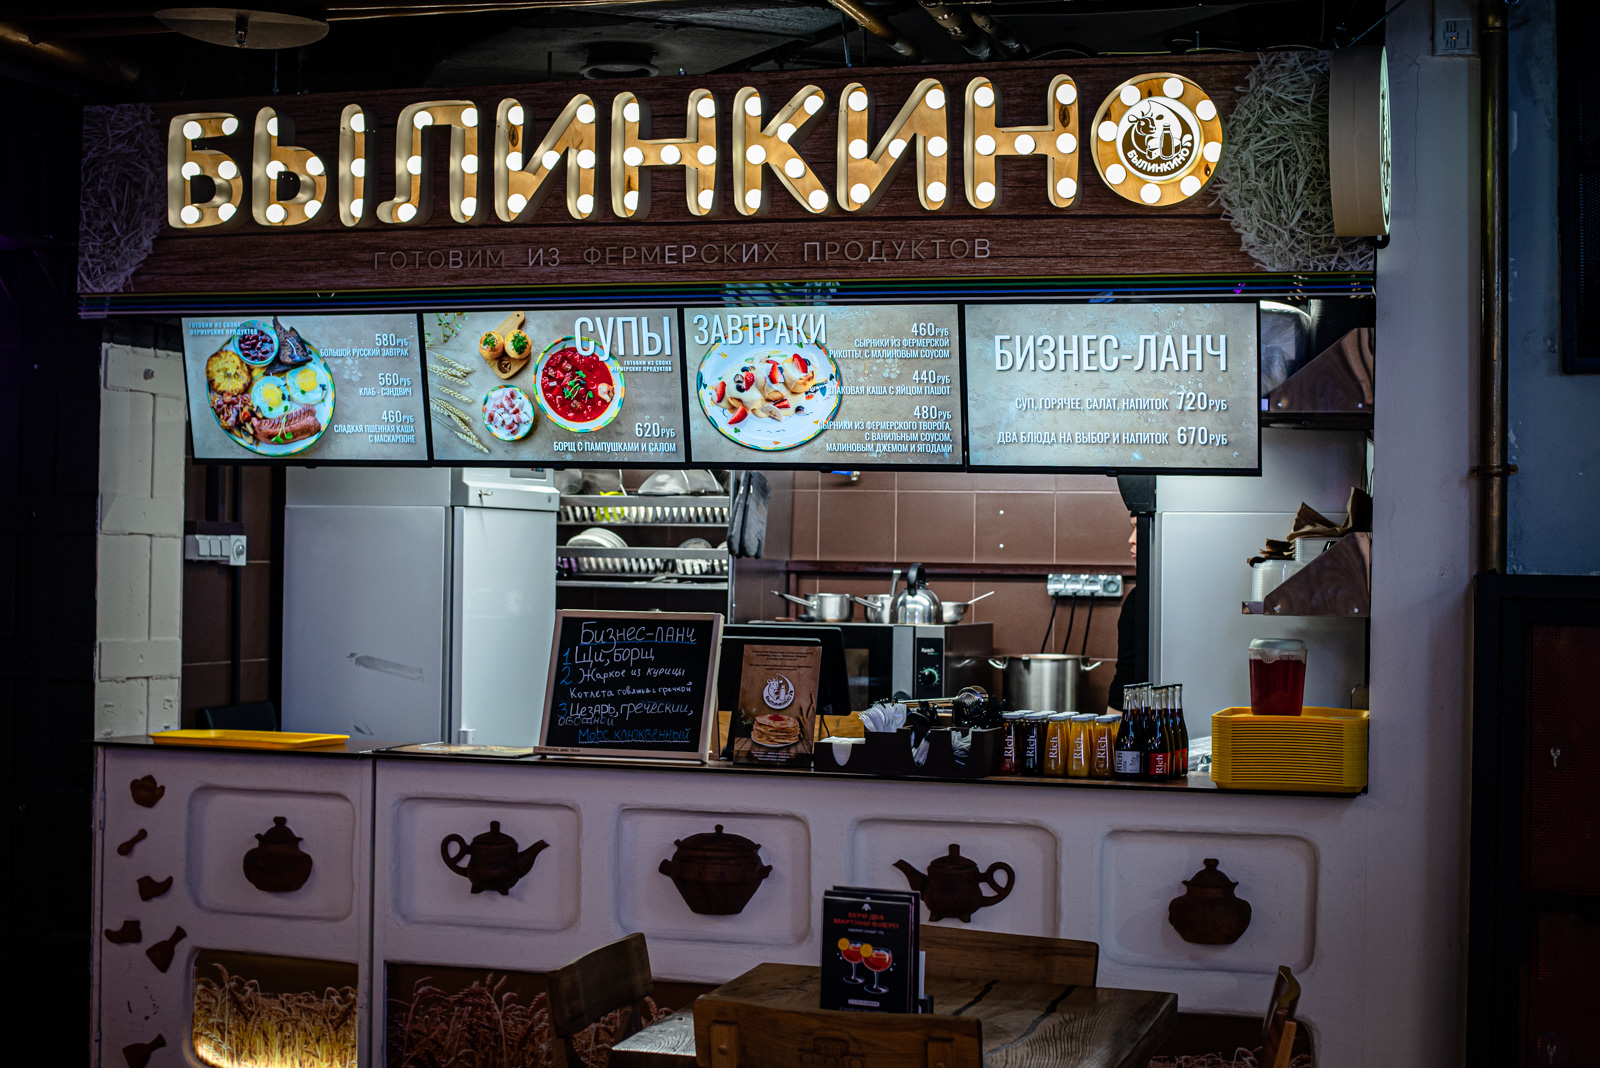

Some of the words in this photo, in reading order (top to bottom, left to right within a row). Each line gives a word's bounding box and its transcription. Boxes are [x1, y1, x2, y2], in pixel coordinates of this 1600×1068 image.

[166, 73, 1223, 229] БЫЛИНКИНО
[1126, 147, 1190, 173] БЫЛИНКИНО
[373, 249, 507, 270] ГОТОВИМ
[528, 247, 561, 267] ИЗ
[583, 243, 780, 266] ФЕРМЕРСКИХ
[803, 238, 991, 263] ПРОДУКТОВ
[693, 313, 827, 345] ЗАВТРАКИ
[574, 316, 672, 361] СУПЫ
[854, 338, 890, 348] СЫРНИКИ
[891, 338, 900, 347] ИЗ
[902, 337, 950, 348] ФЕРМЕРСКОЙ
[320, 347, 351, 357] БОЛЬШОЙ
[352, 347, 380, 358] РУССКИЙ
[381, 348, 409, 357] ЗАВТРАК
[829, 349, 863, 359] РИКОТТЫ,
[864, 350, 870, 359] С
[871, 349, 918, 359] МАЛИНОВЫМ
[920, 349, 950, 359] СОУСОМ
[994, 334, 1228, 372] БИЗНЕС-ЛАНЧ
[359, 388, 376, 396] КЛАБ
[381, 388, 412, 397] СЭНДВИЧ
[827, 386, 865, 395] ЗЛАКОВАЯ
[866, 386, 887, 395] КАША
[889, 386, 894, 395] С
[896, 385, 922, 396] ЯЙЦОМ
[924, 386, 950, 395] ПАШОТ
[1015, 398, 1037, 412] СУП,
[1039, 398, 1084, 412] ГОРЯЧЕЕ,
[1085, 398, 1120, 411] САЛАТ,
[1122, 398, 1168, 410] НАПИТОК
[334, 424, 363, 434] СЛАДКАЯ
[364, 424, 395, 433] ПШЕННАЯ
[396, 425, 415, 433] КАША
[854, 421, 864, 430] ИЗ
[866, 421, 917, 430] ФЕРМЕРСКОГО
[919, 422, 952, 431] ТВОРОГА,
[368, 434, 373, 443] С
[374, 434, 416, 443] МАСКАРПОНЕ
[864, 432, 870, 441] С
[872, 432, 919, 441] ВАНИЛЬНЫМ
[920, 432, 952, 442] СОУСОМ,
[997, 431, 1018, 445] ДВА
[1020, 431, 1056, 445] БЛЮДА
[1060, 432, 1073, 444] НА
[1076, 432, 1110, 444] ВЫБОР
[1113, 432, 1120, 444] И
[1123, 432, 1169, 444] НАПИТОК
[553, 442, 577, 452] БОРЩ
[578, 442, 583, 452] С
[585, 442, 639, 452] ПАМПУШКАМИ
[641, 443, 647, 452] И
[648, 443, 677, 452] САЛОМ
[826, 443, 874, 452] МАЛИНОВЫМ
[875, 443, 909, 453] ДЖЕМОМ
[910, 444, 916, 452] И
[917, 443, 953, 454] ЯГОДАМИ
[560, 666, 572, 685] 2
[578, 668, 626, 684] Жаркое
[631, 668, 641, 677] из
[569, 686, 615, 699] Котлета
[557, 702, 568, 718] 3
[1004, 735, 1013, 756] Rich
[1026, 735, 1035, 756] Rich
[1049, 736, 1058, 758] Rich
[1073, 737, 1082, 759] Rich
[1097, 736, 1106, 758] Rich
[1155, 754, 1163, 773] Rich
